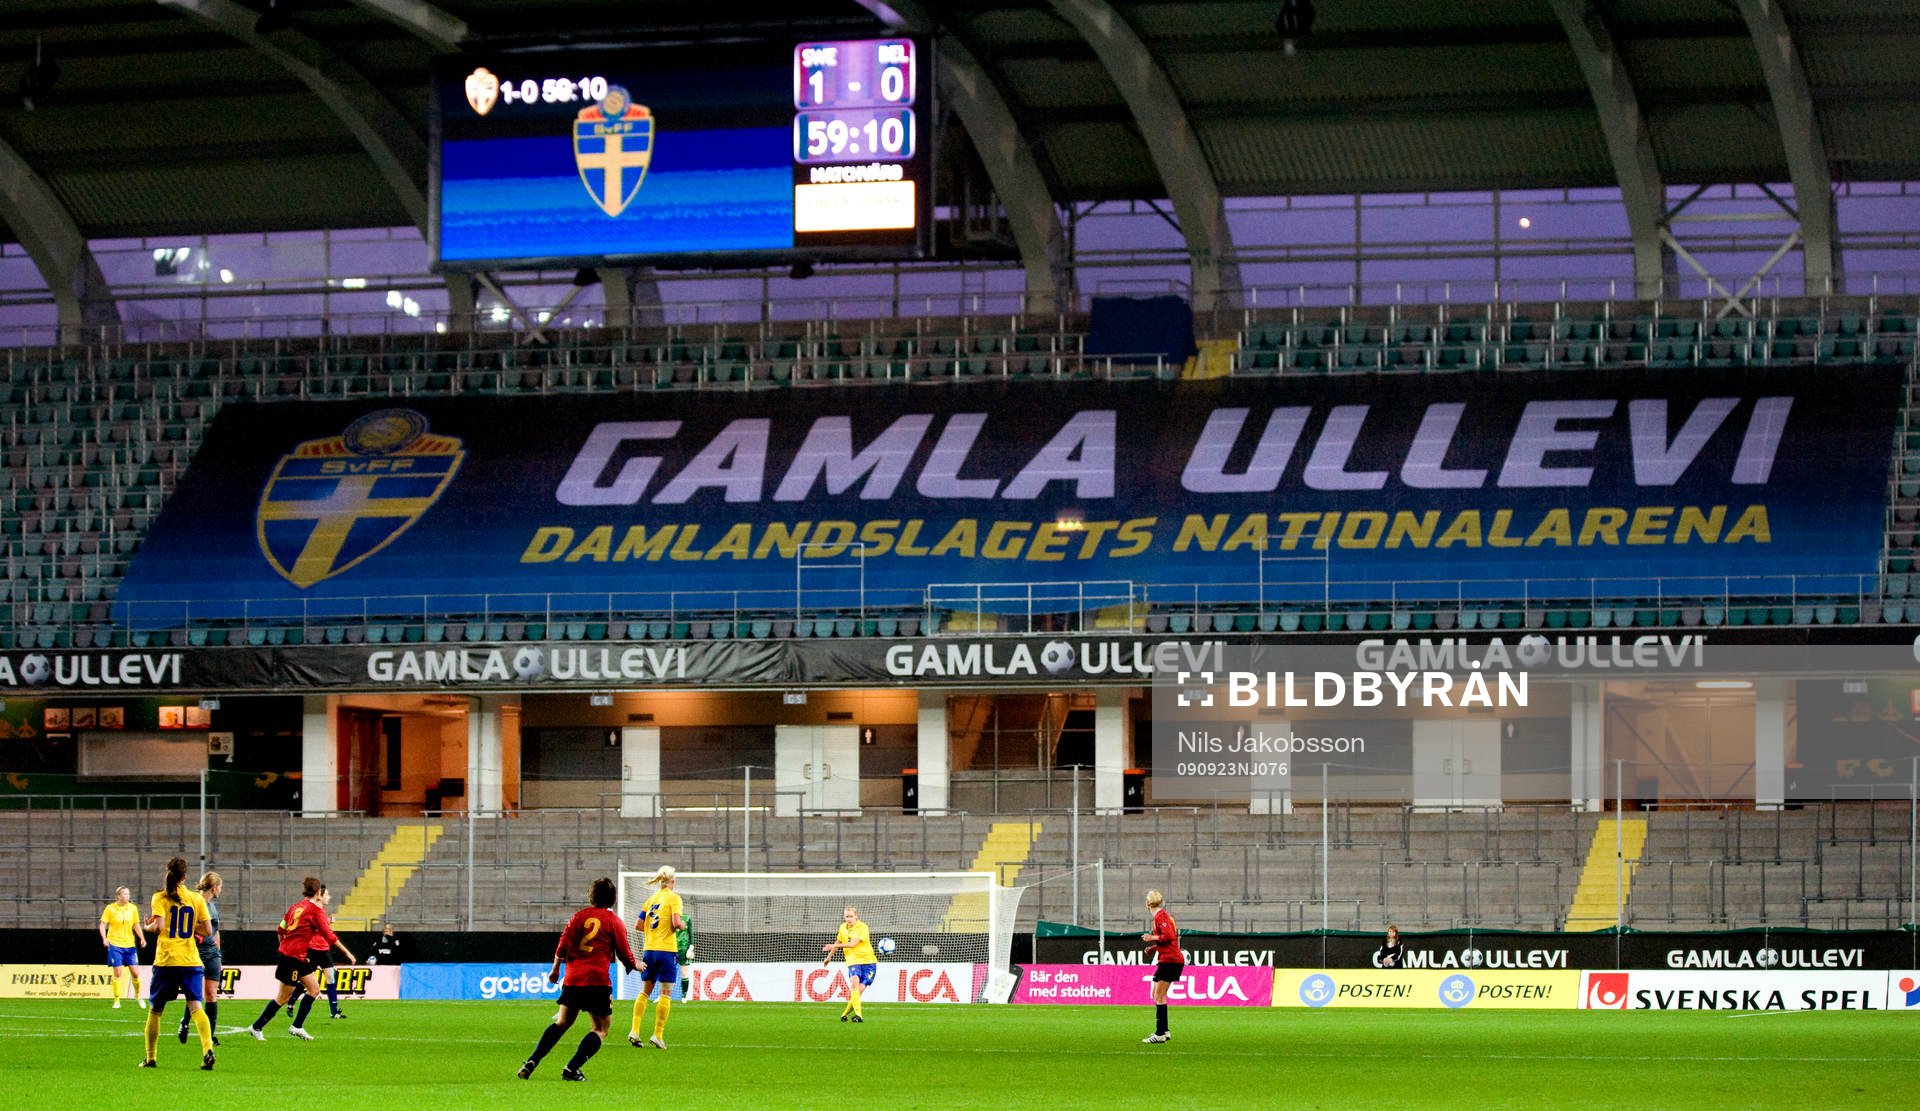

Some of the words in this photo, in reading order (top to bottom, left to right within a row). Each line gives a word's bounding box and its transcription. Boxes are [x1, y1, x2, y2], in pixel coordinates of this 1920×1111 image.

[809, 70, 824, 104] 1
[881, 66, 904, 101] 0
[807, 117, 904, 155] 59:10
[319, 457, 415, 475] SvFF
[556, 409, 1116, 506] GAMLA
[1181, 396, 1794, 493] ULLEVI
[519, 516, 1159, 564] DAMLANDSLAGETS
[1172, 503, 1772, 553] NATIONALARENA
[55, 653, 181, 686] ULLEVI
[367, 650, 509, 682] GAMLA
[550, 647, 687, 679] ULLEVI
[885, 643, 1039, 677] GAMLA
[1080, 640, 1225, 674] ULLEVI
[1356, 638, 1513, 672] GAMLA
[1557, 635, 1704, 668] ULLEVI
[169, 905, 195, 939] 10
[578, 917, 602, 952] 2
[1194, 950, 1274, 967] ULLEVI
[1372, 950, 1459, 968] GMLA
[1485, 950, 1567, 968] ULLEVI
[1667, 949, 1755, 968] GAMLA
[1778, 948, 1863, 968] ULLEVI
[11, 974, 58, 985] FOREX
[480, 972, 565, 999] go:teb
[693, 969, 752, 1001] ICA
[795, 969, 851, 1002] ICA
[898, 969, 960, 1003] ICA
[1029, 985, 1057, 997] med
[1060, 985, 1111, 998] stolthet
[1030, 970, 1052, 982] Bär
[1054, 970, 1078, 982] den
[1338, 984, 1412, 998] POSTEN!
[1478, 985, 1553, 998] POSTEN!
[1635, 989, 1785, 1010] SVENSKA
[1800, 989, 1878, 1010] SPEL
